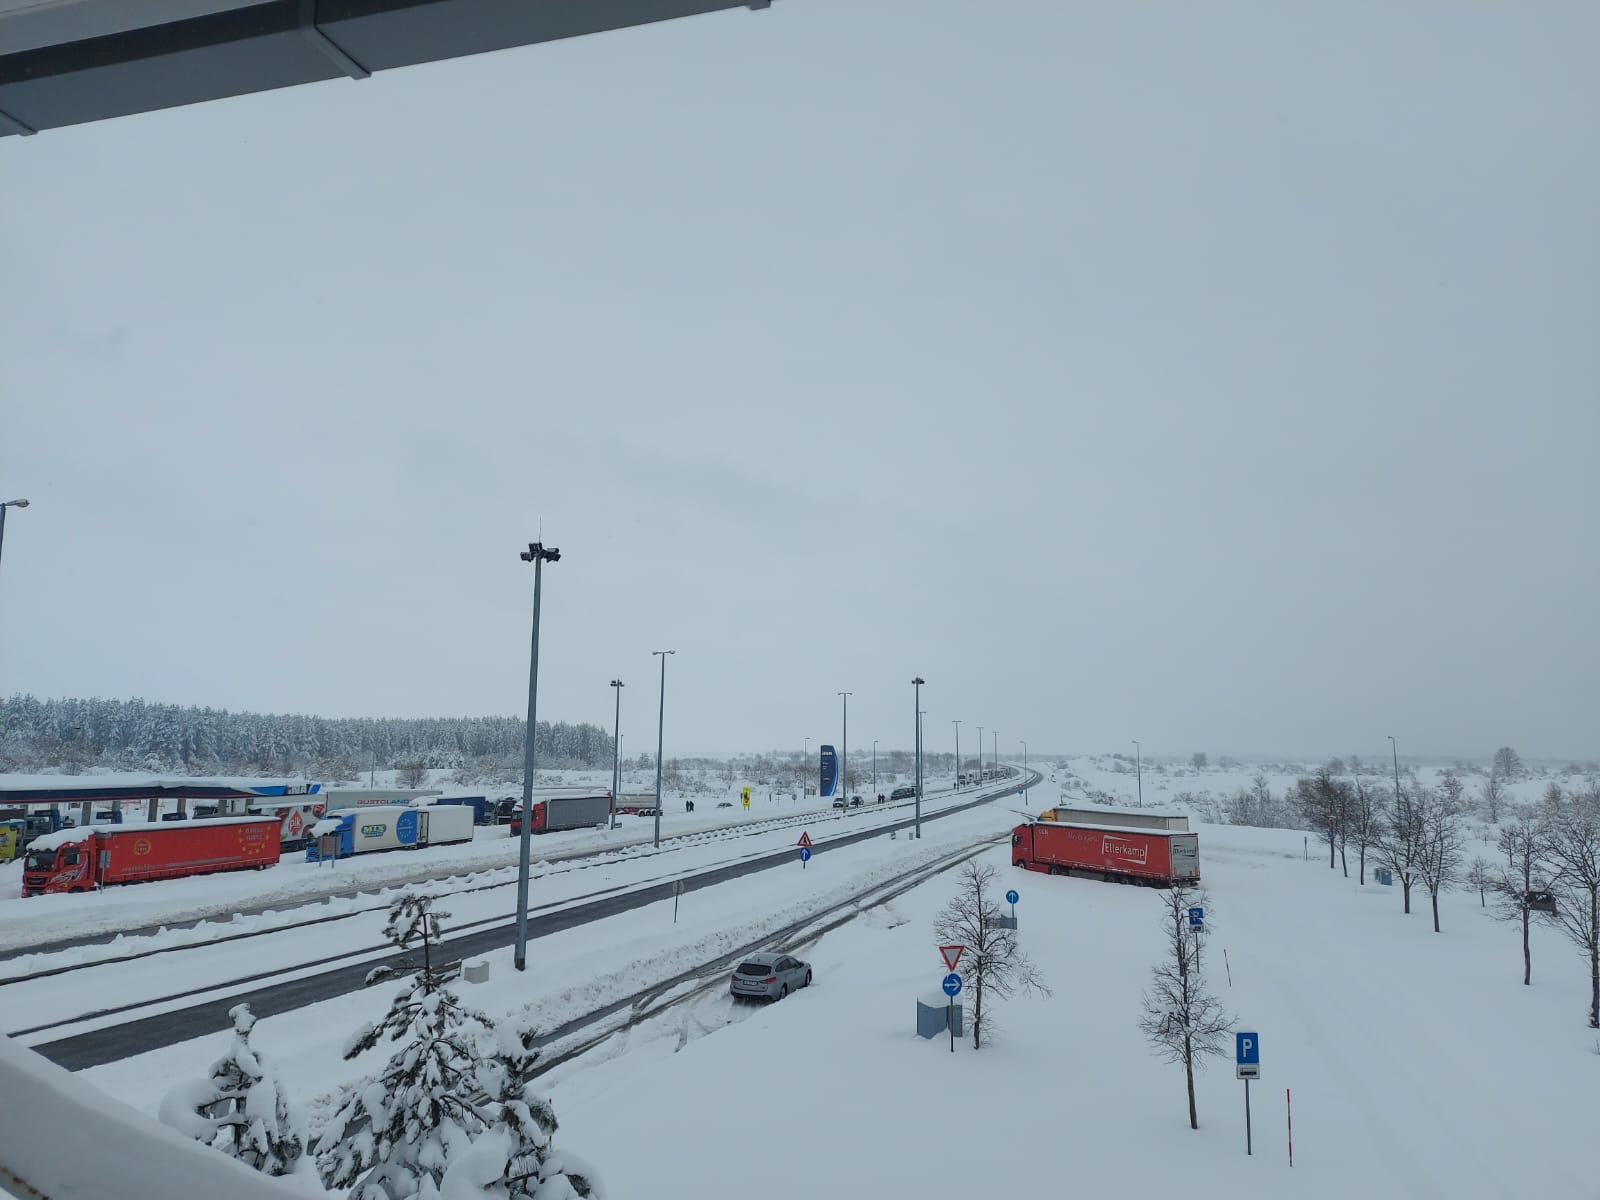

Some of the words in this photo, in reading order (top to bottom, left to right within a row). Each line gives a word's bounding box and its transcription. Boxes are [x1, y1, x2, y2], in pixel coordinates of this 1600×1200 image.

[290, 816, 301, 831] pik
[1104, 842, 1145, 857] Ellerkamp
[1242, 1038, 1253, 1058] P
